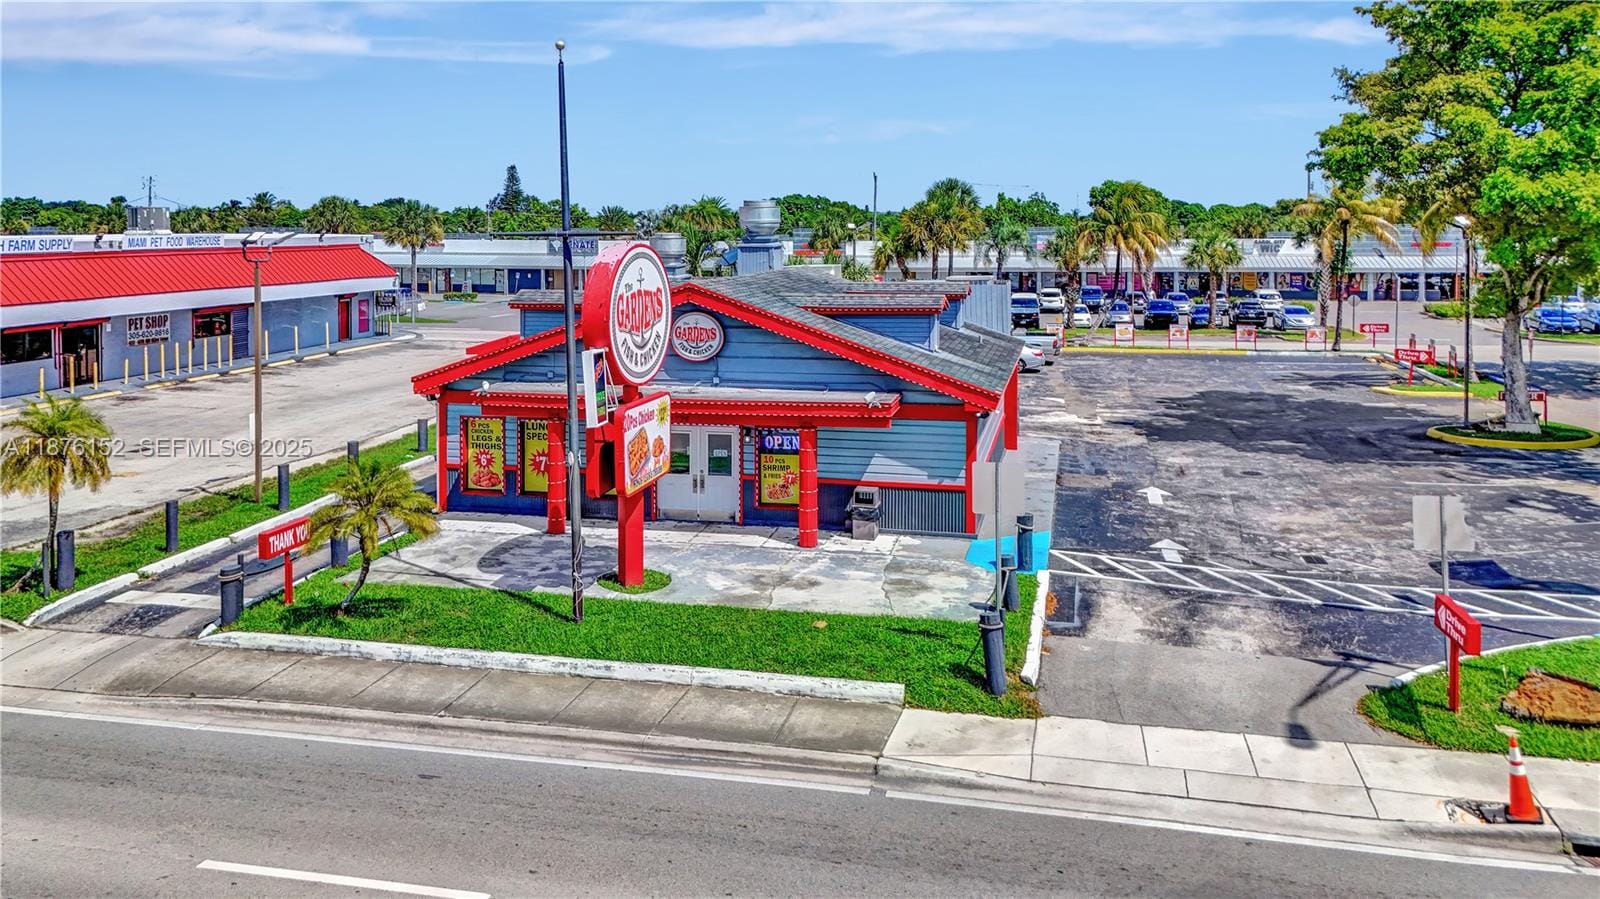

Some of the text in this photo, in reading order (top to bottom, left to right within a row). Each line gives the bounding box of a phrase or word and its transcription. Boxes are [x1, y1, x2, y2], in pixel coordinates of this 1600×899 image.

[8, 239, 35, 251] FARM
[38, 238, 73, 250] SUPPLY
[128, 235, 221, 248] MIAMI PET FOOD WAREHOUSE
[570, 240, 594, 249] NATE
[1260, 244, 1280, 253] WIC
[624, 282, 633, 294] The
[616, 287, 664, 333] GARDENS
[128, 314, 169, 331] PET SHOP
[674, 325, 717, 343] GARDENS
[621, 337, 635, 364] FISH
[640, 330, 662, 367] CHICKEN
[678, 341, 689, 352] FISH
[692, 344, 715, 356] CHICKEN
[638, 408, 655, 426] Chicken
[470, 420, 477, 429] 6
[525, 421, 548, 431] LUN
[471, 434, 493, 442] LEGS
[526, 432, 548, 441] SPEC
[764, 435, 800, 450] OPEN
[471, 442, 502, 450] THIGHS
[763, 455, 774, 464] 10
[762, 464, 791, 472] SHRIMP
[269, 528, 296, 554] THANK
[1446, 609, 1466, 636] Drive
[1446, 621, 1464, 646] Thru
